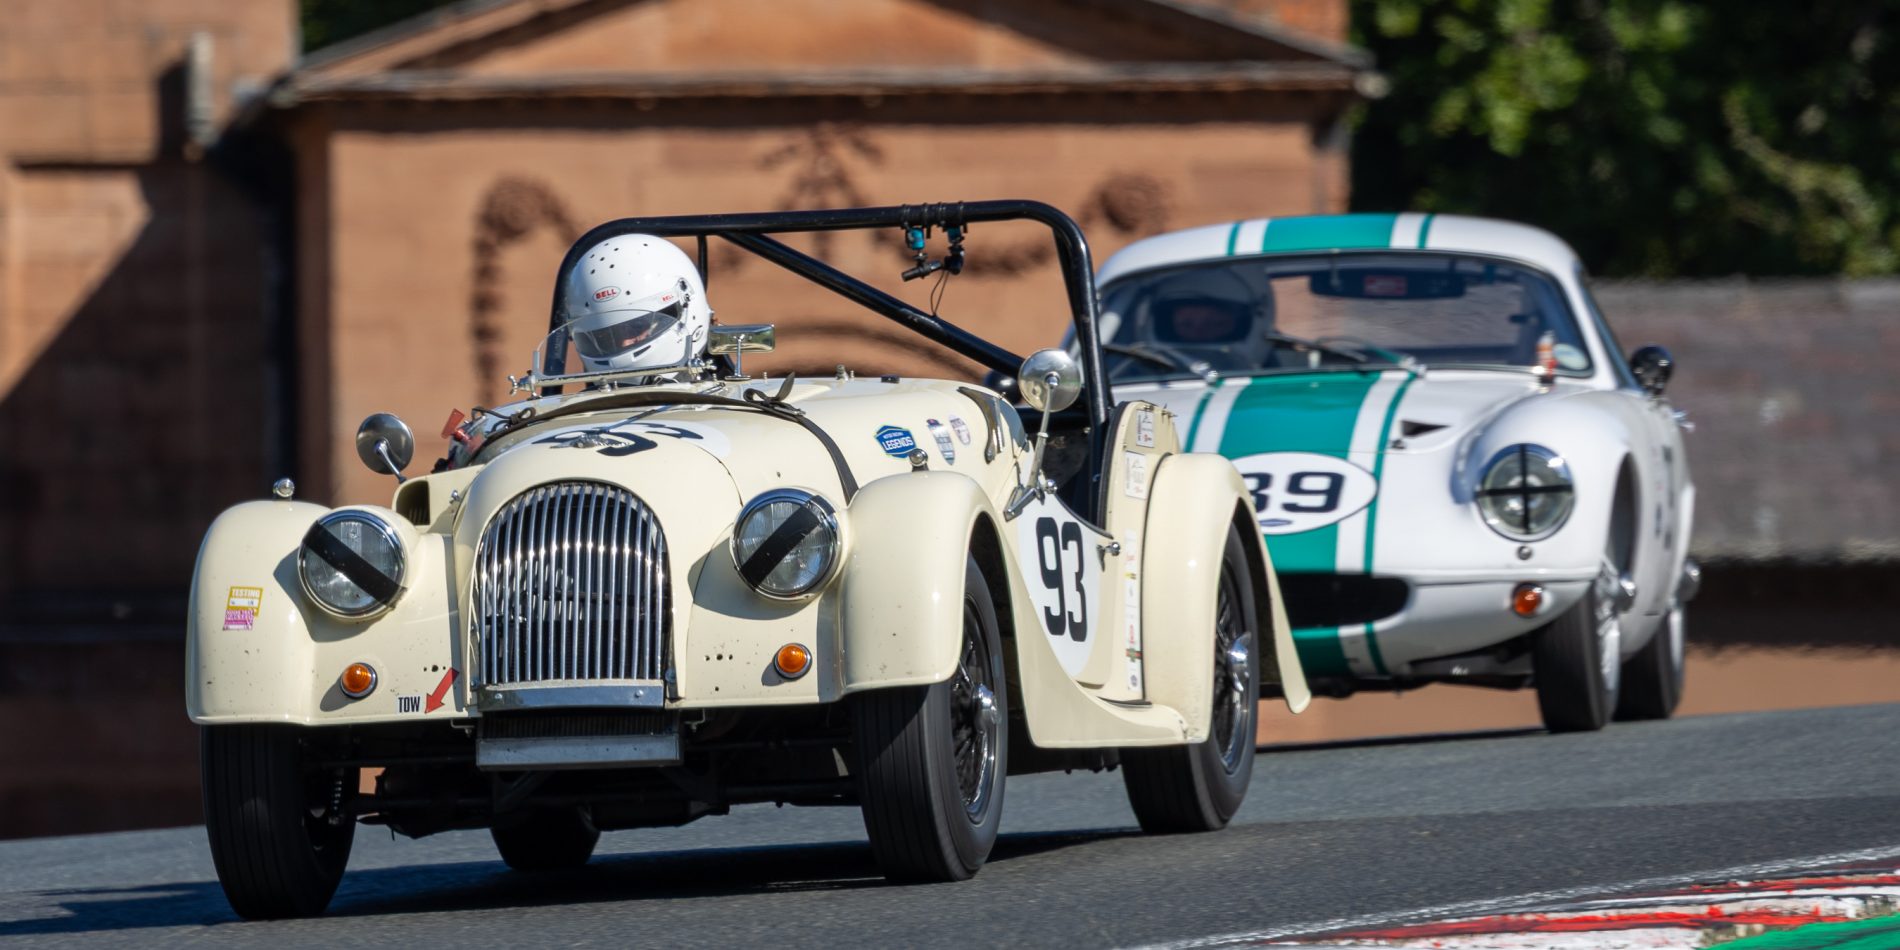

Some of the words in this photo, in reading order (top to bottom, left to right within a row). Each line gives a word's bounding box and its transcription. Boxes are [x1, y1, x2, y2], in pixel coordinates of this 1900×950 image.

[596, 289, 616, 299] BELL
[882, 436, 914, 451] LEGENDS
[1036, 517, 1087, 642] 93
[231, 589, 260, 599] TESTING
[398, 696, 420, 713] TOW
